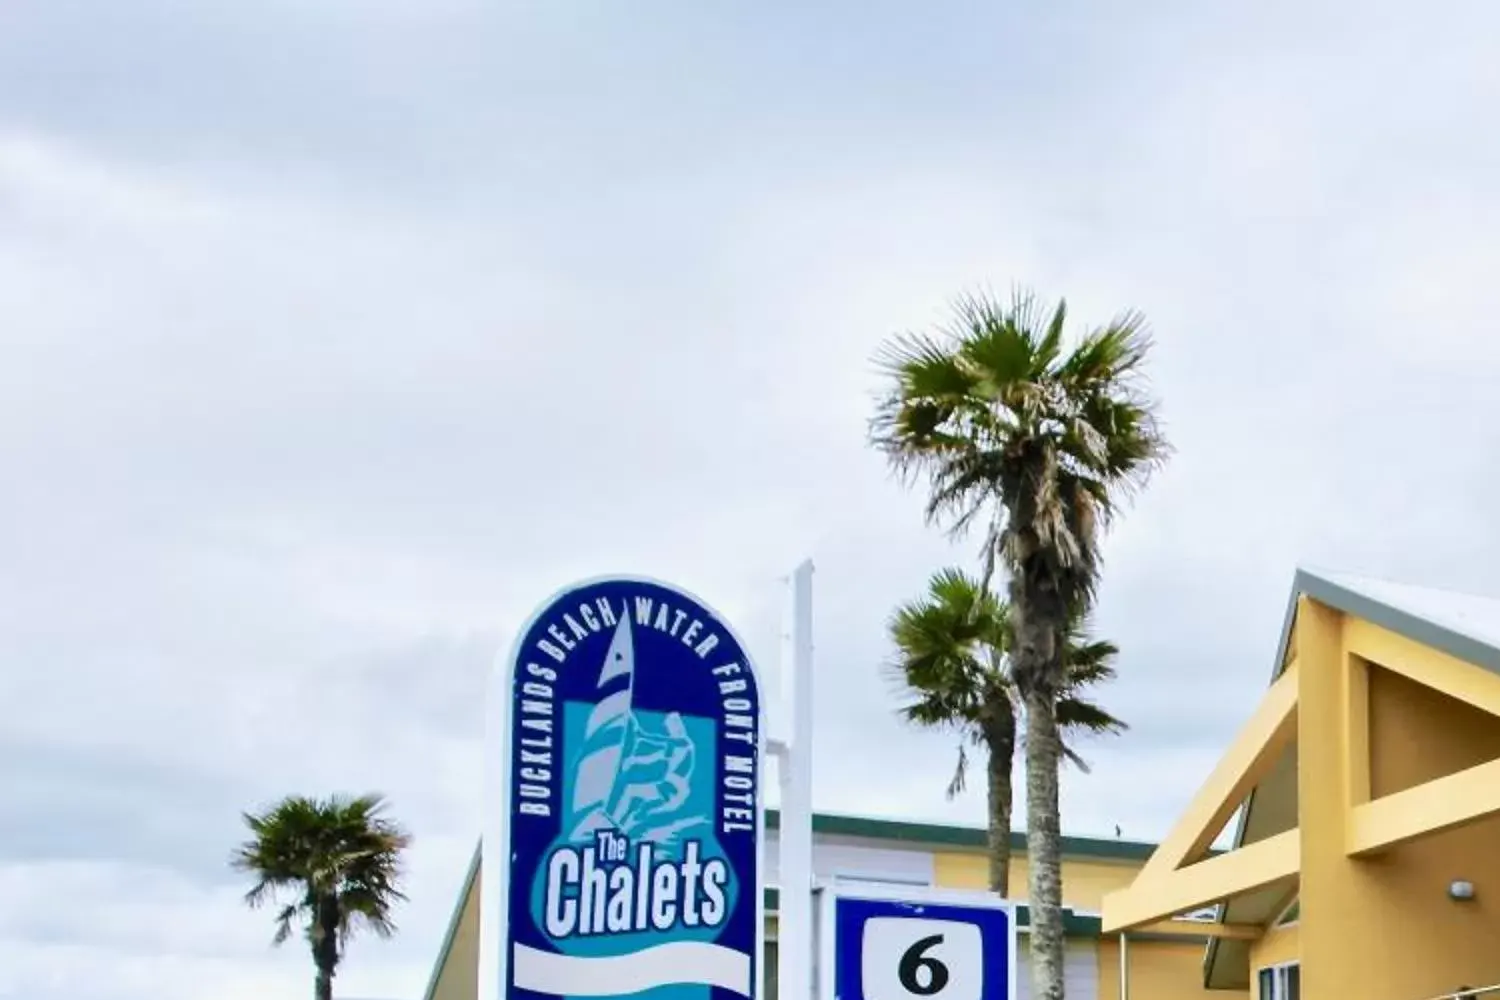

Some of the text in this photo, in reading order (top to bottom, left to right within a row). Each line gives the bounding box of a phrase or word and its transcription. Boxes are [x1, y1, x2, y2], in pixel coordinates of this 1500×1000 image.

[519, 595, 754, 833] BUCKLANDS BEACH WATER FRONT MOTEL
[598, 831, 626, 861] The
[546, 841, 727, 938] Chalets
[898, 933, 949, 996] 6
